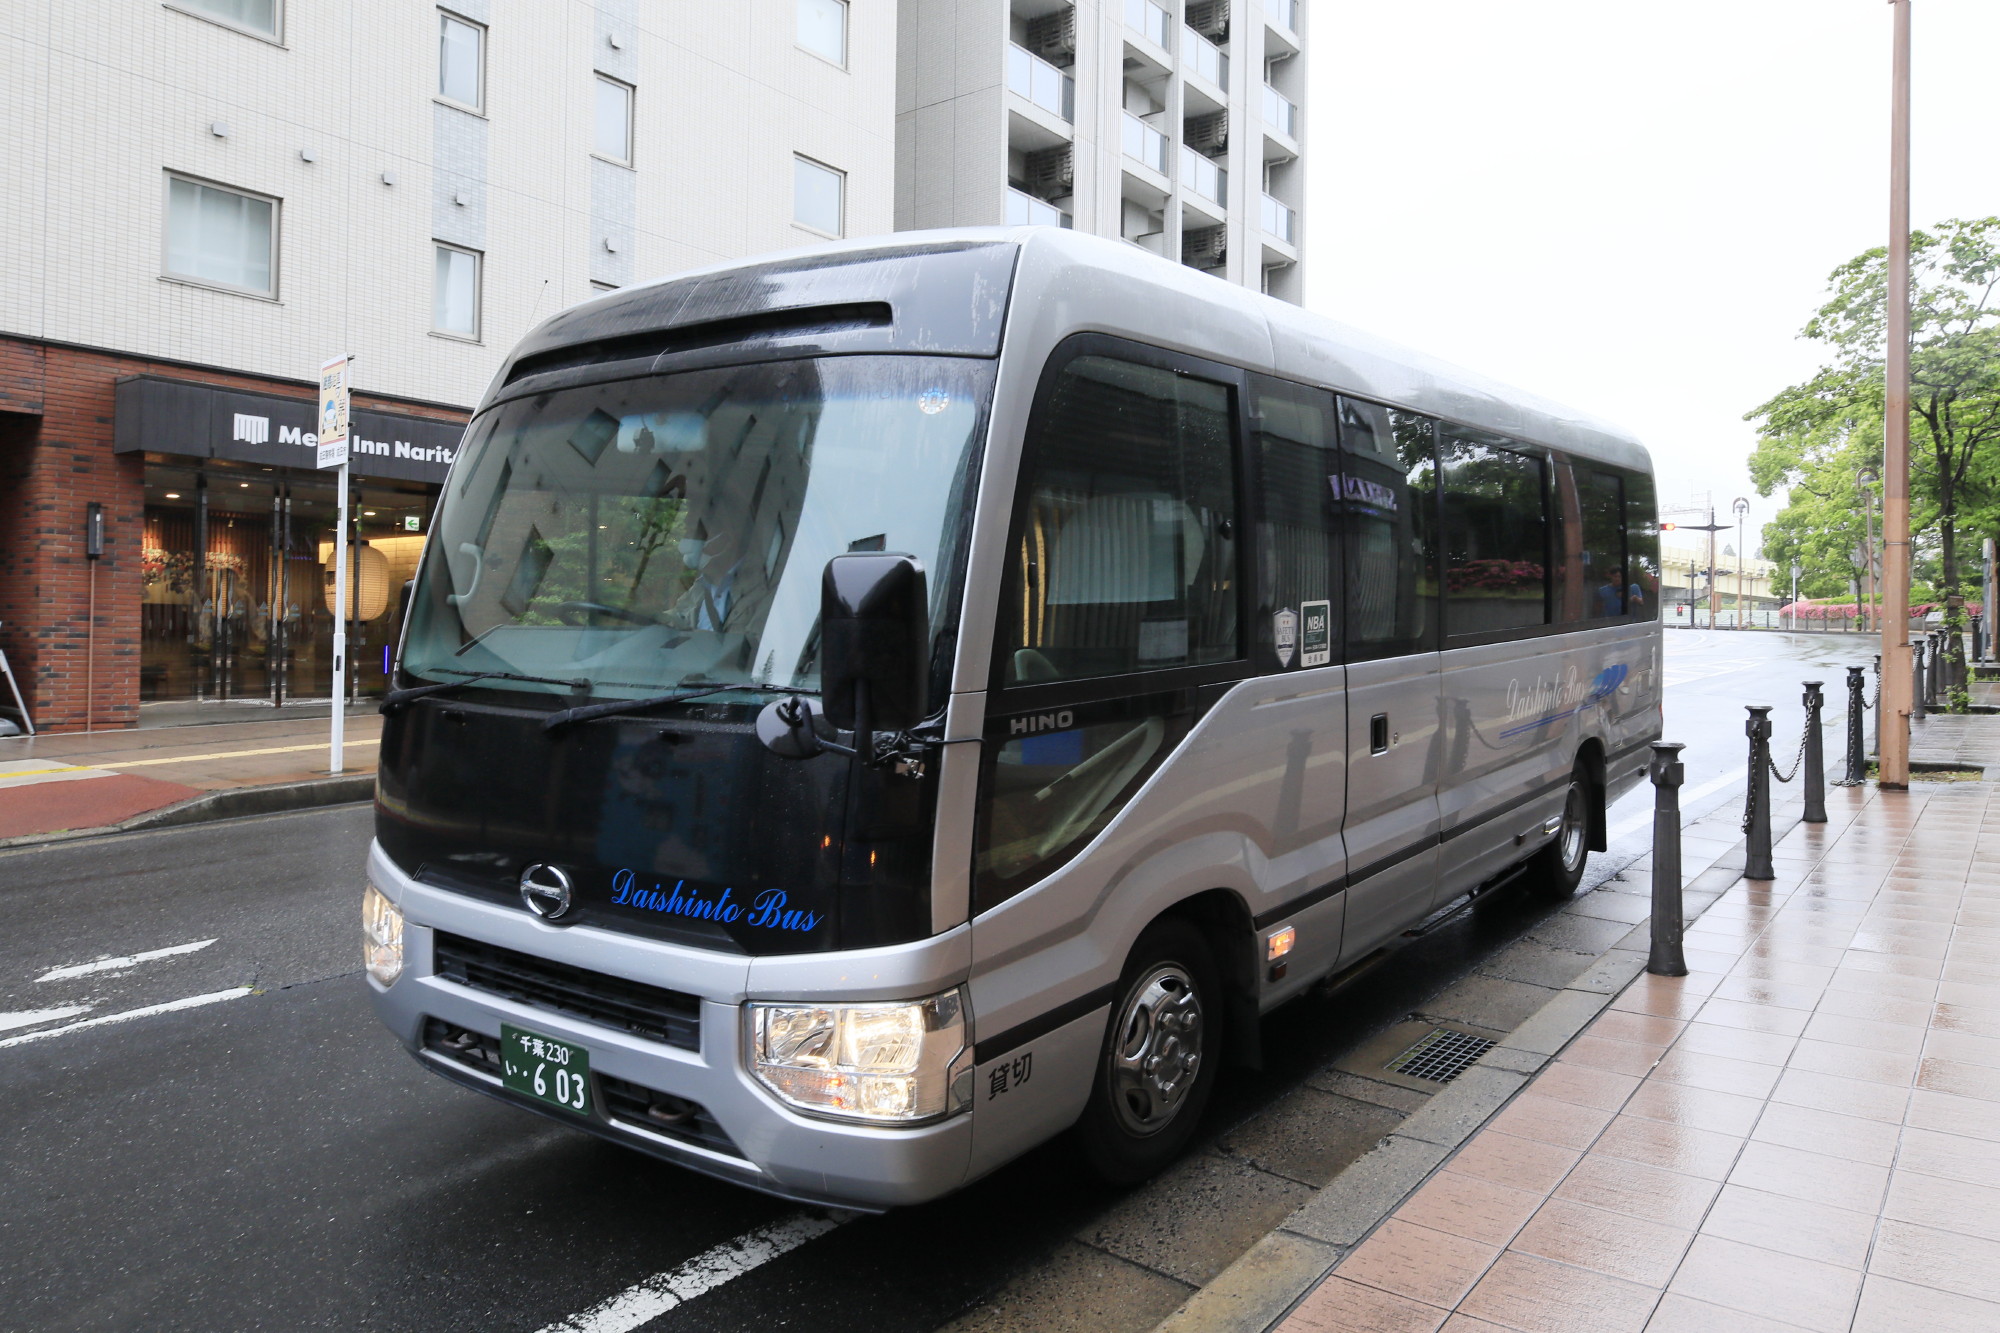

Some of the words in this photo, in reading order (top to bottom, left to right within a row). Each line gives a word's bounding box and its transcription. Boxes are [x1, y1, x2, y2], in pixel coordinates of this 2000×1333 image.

[353, 435, 390, 457] Inn
[394, 441, 458, 465] Narit
[1307, 615, 1325, 631] NBA
[1010, 710, 1073, 735] HINO
[610, 868, 745, 924] Daishinto
[748, 888, 825, 932] Bus
[988, 1052, 1033, 1101] 貸切
